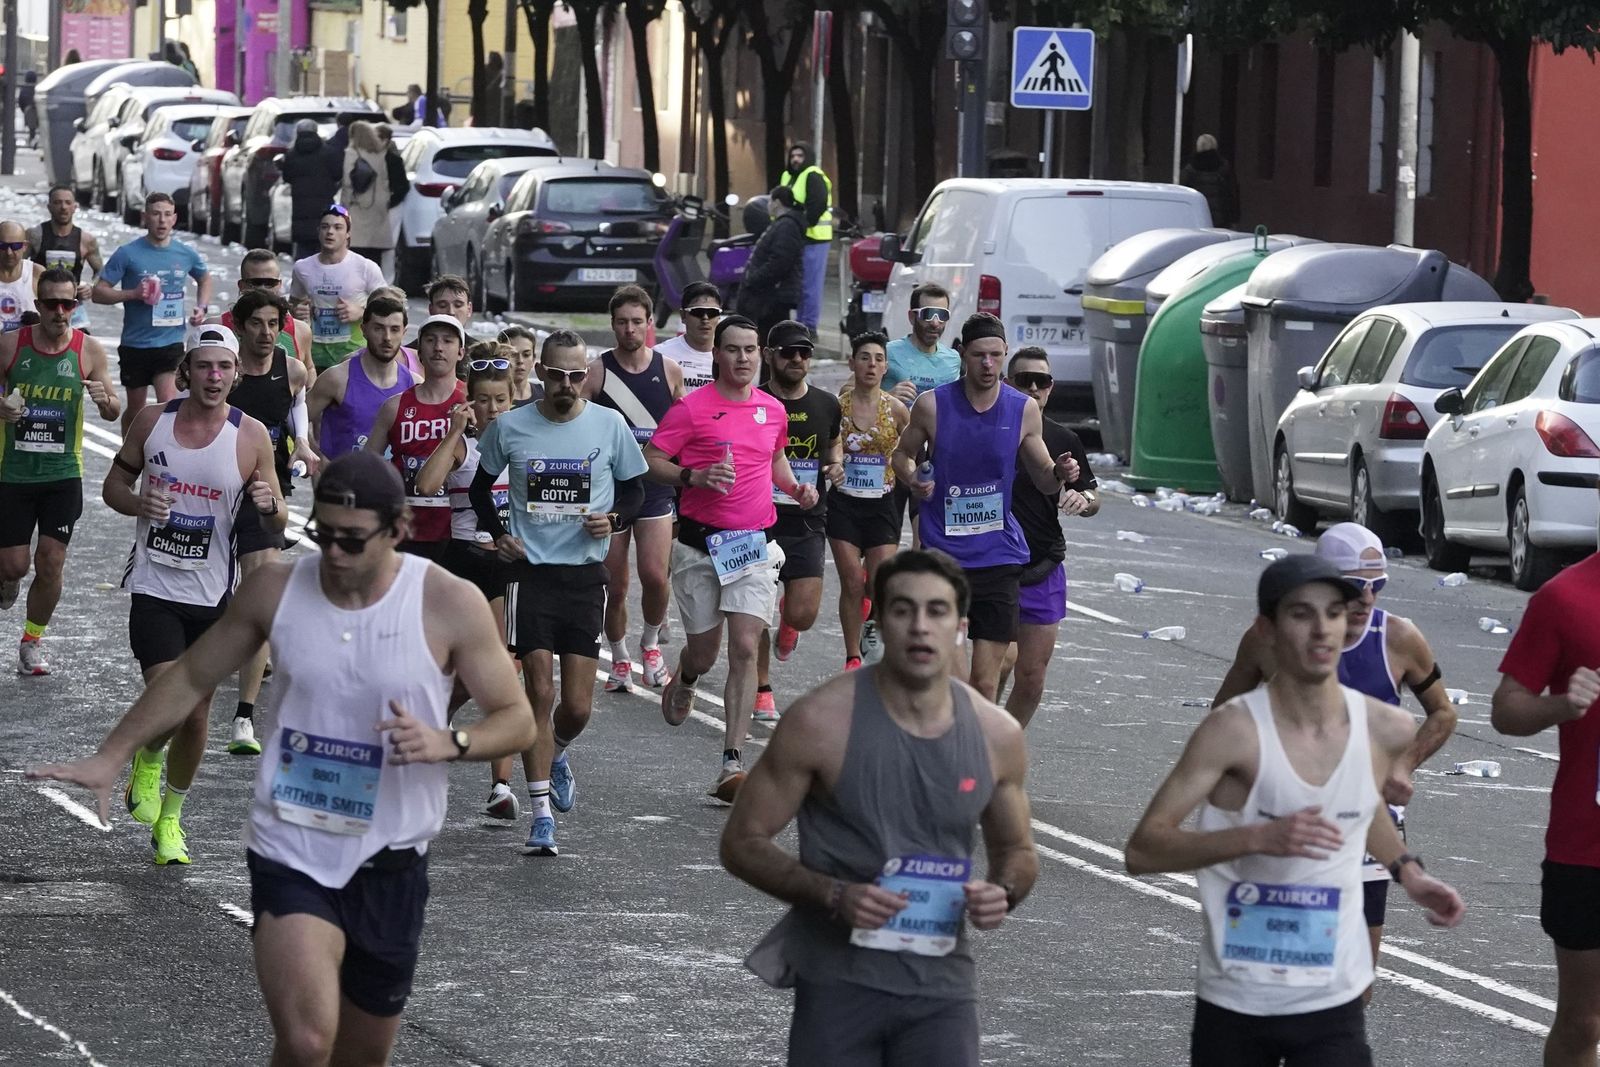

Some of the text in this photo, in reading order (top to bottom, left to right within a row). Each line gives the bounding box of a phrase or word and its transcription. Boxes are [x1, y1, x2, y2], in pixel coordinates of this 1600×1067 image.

[1026, 328, 1085, 340] 9177 MFY
[24, 432, 54, 442] ANGEL
[550, 462, 584, 471] ZURICH
[550, 478, 568, 486] 4160
[846, 476, 874, 487] PITINA
[541, 489, 578, 502] GOTYF
[964, 484, 996, 495] ZURICH
[174, 516, 208, 527] ZURICH
[952, 510, 997, 524] THOMAS
[172, 532, 190, 543] 4414
[153, 536, 204, 558] CHARLES
[731, 543, 748, 554] 9720
[722, 549, 760, 572] YOHANN
[313, 741, 371, 762] ZURICH
[272, 784, 374, 817] ARTHUR SMITS
[904, 860, 958, 876] ZURICH
[1266, 889, 1329, 906] ZURICH
